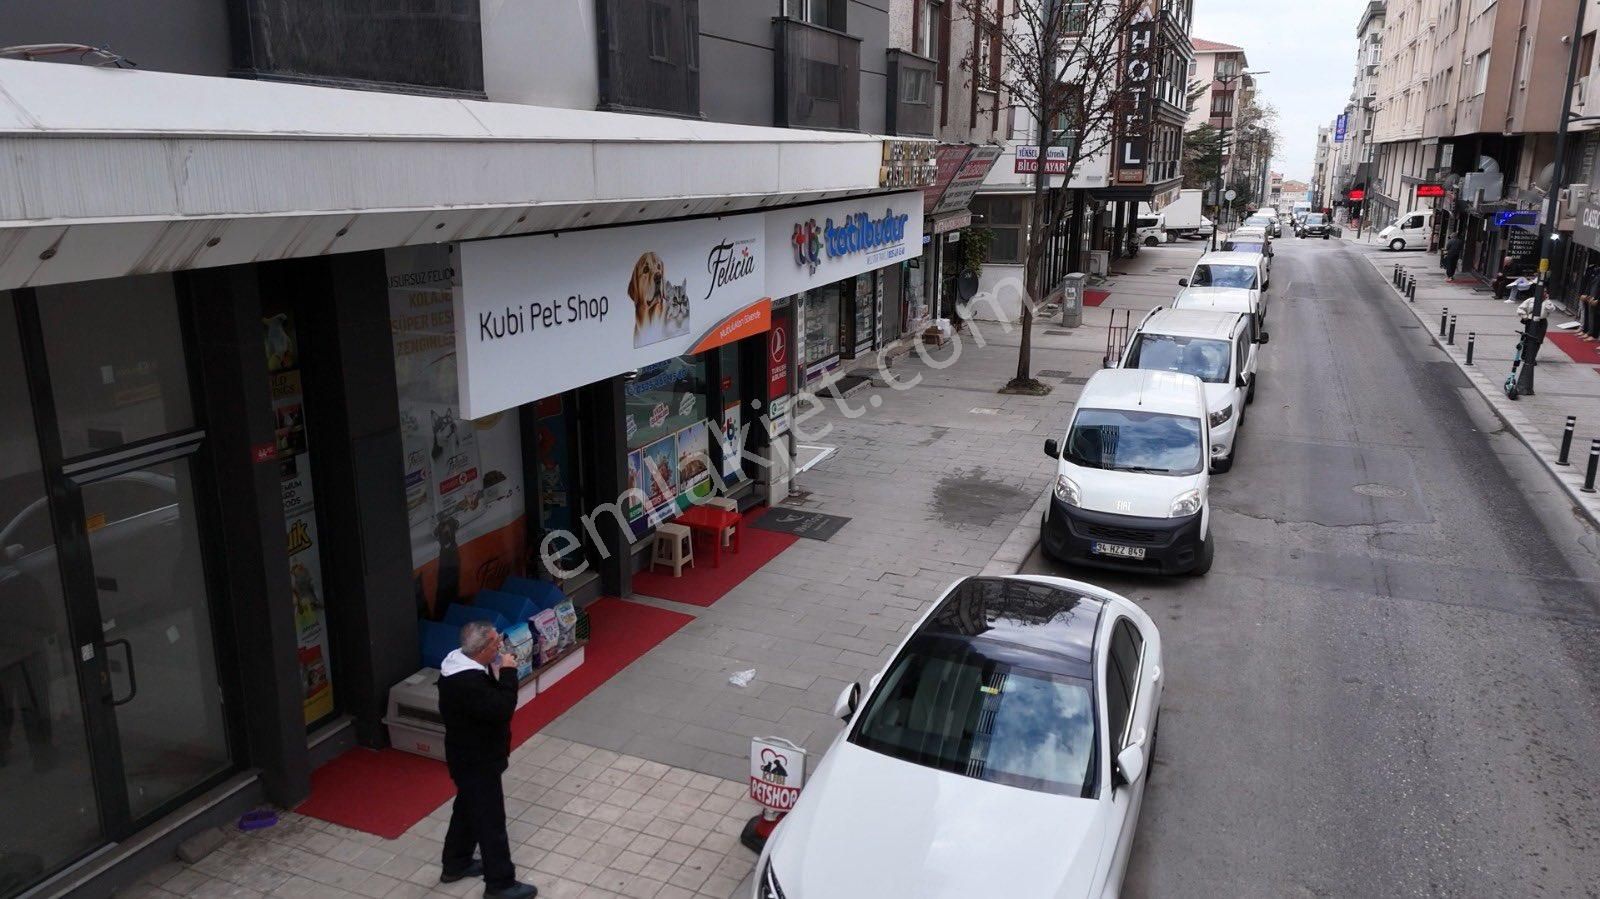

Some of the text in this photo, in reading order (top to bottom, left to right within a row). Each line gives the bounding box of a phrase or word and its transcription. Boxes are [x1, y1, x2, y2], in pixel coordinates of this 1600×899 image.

[1017, 159, 1066, 172] BİLGAYAR
[824, 207, 909, 259] tatilbudur
[704, 237, 755, 300] Felicia
[479, 294, 609, 342] Kubi Pet Shop
[1117, 500, 1131, 510] FIAT
[1109, 544, 1126, 554] HZZ
[1128, 546, 1144, 557] 849
[751, 779, 799, 808] PETSHOP
